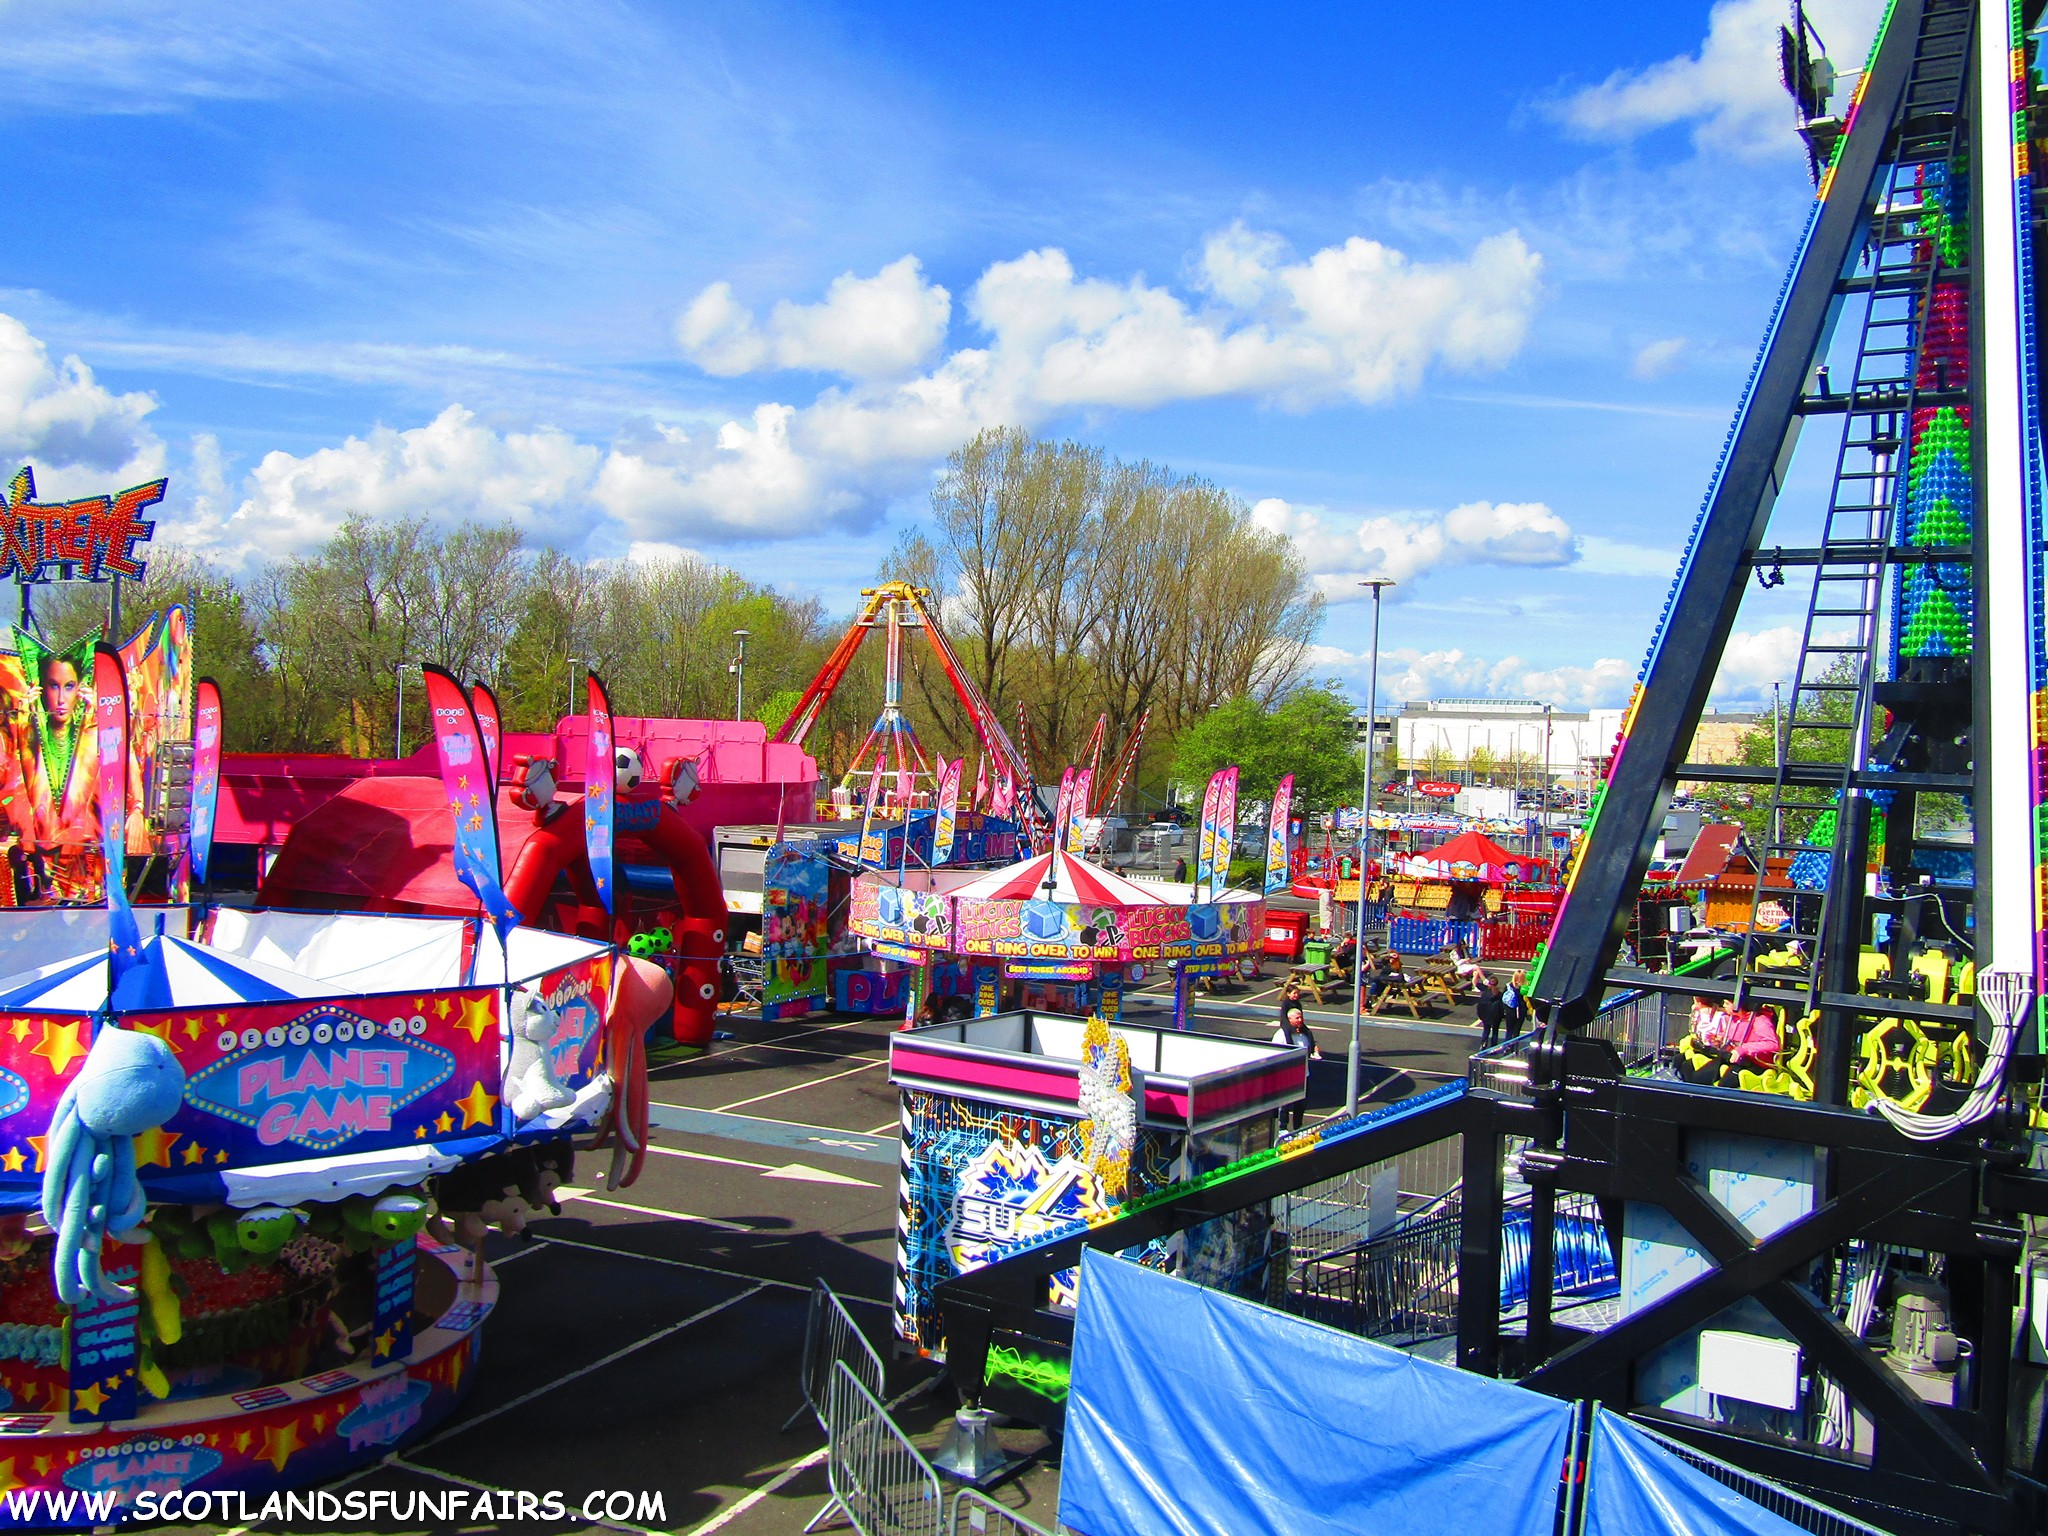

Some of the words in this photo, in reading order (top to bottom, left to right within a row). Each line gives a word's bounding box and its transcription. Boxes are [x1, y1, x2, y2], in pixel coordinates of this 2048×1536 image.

[1420, 783, 1456, 794] Cars
[966, 831, 1016, 863] GAME
[960, 900, 1023, 921] LUCKY
[1127, 904, 1188, 929] LUCKY
[881, 927, 905, 943] OVER
[907, 932, 922, 945] TO
[924, 933, 947, 948] WIN
[964, 918, 1021, 940] RINGS
[1128, 921, 1191, 949] BLOCKS
[965, 939, 992, 954] ONE
[995, 941, 1027, 956] RING
[1030, 943, 1068, 958] OVER
[1070, 945, 1090, 959] TO
[1093, 945, 1118, 959] WIN
[1132, 946, 1160, 959] ONE
[1163, 945, 1192, 959] RING
[1194, 943, 1223, 957] OVER
[1226, 942, 1236, 954] TO
[1008, 964, 1026, 974] BEST
[1055, 966, 1089, 975] AROUND
[1184, 963, 1200, 974] STEP
[977, 999, 995, 1007] OVER
[978, 991, 995, 999] RING
[1101, 998, 1118, 1006] RING
[1100, 1005, 1119, 1013] OVER
[217, 1019, 376, 1052] WELCOME
[388, 1014, 427, 1038] TO
[238, 1049, 409, 1107] PLANET
[256, 1095, 392, 1146] GAME
[92, 1451, 194, 1487] PLANET
